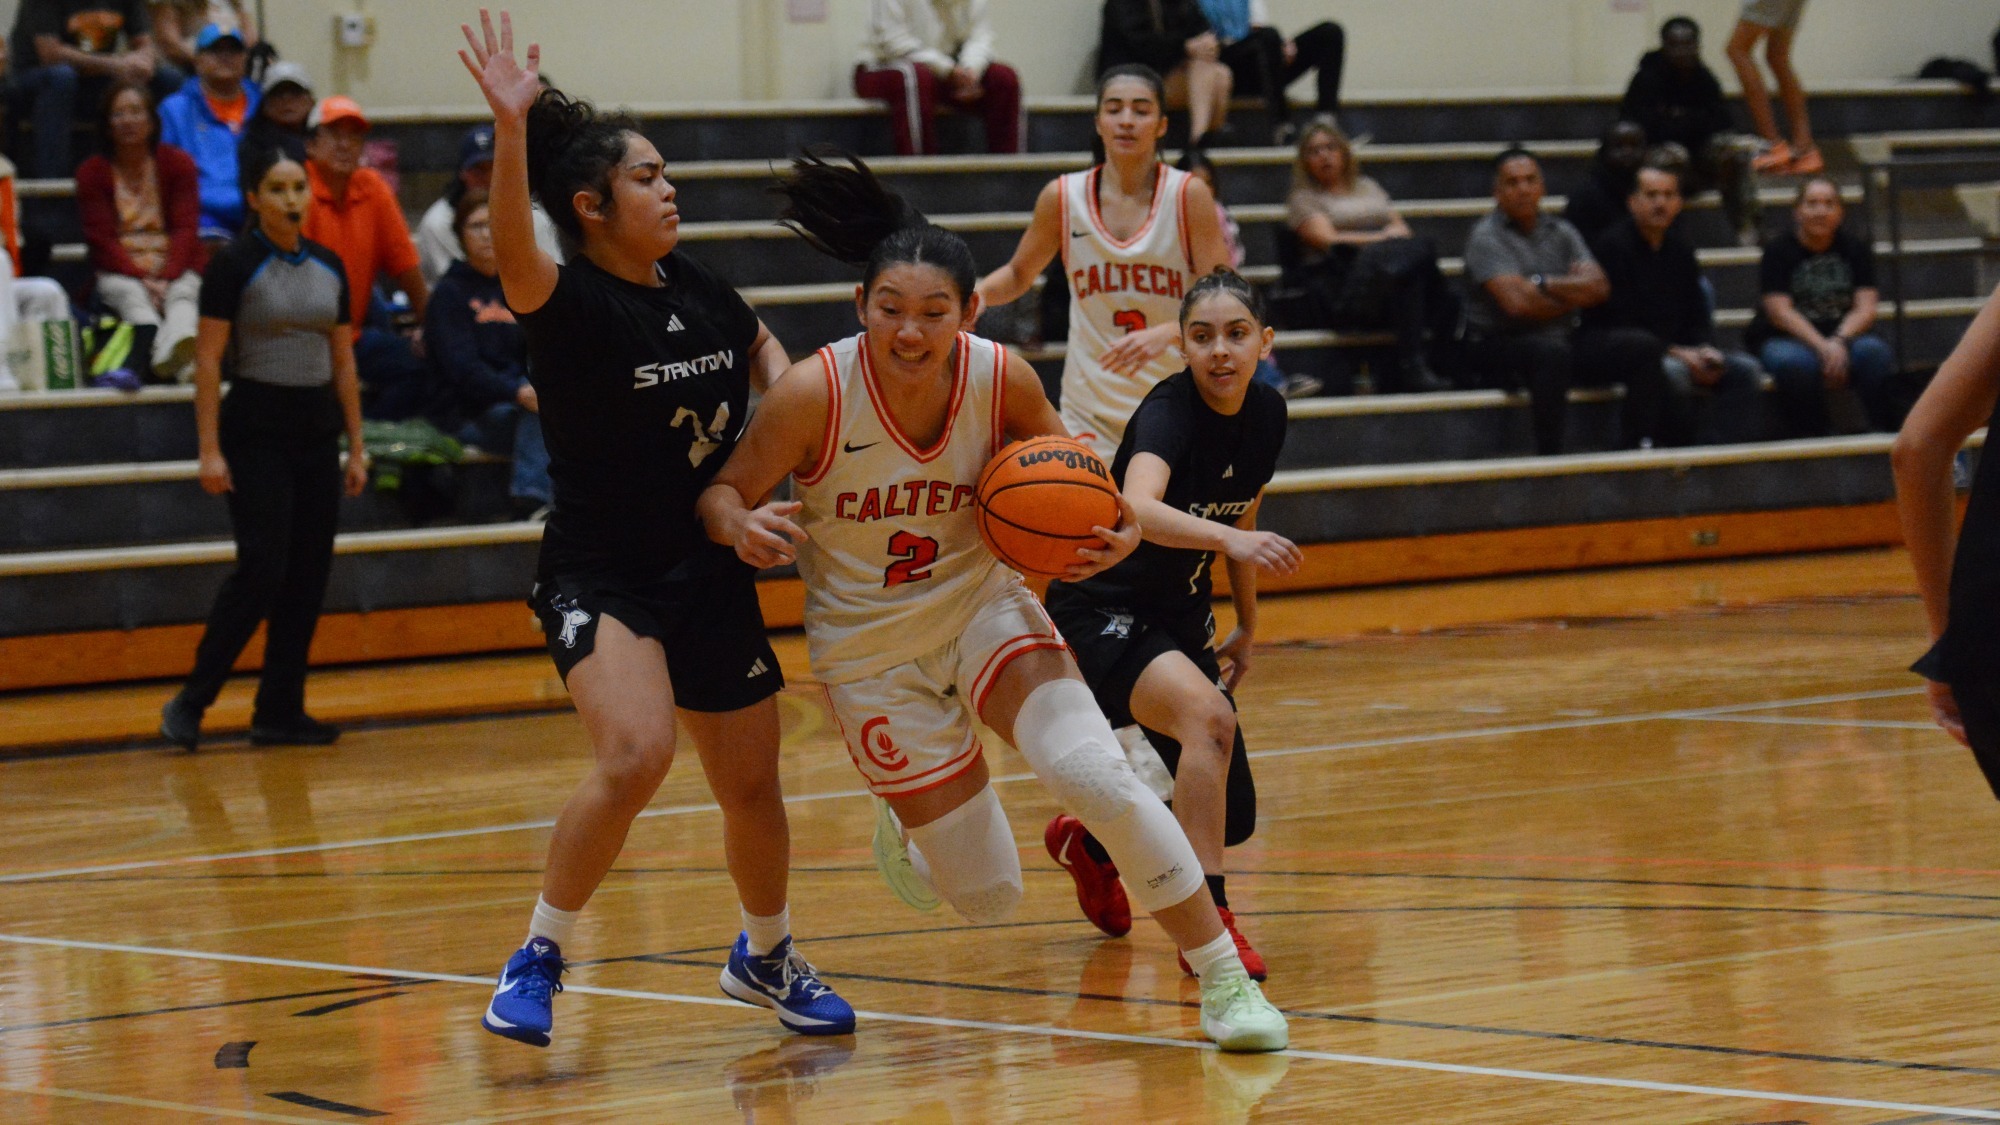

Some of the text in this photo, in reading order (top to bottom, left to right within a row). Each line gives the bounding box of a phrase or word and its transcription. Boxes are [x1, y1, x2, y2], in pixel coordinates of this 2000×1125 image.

[1073, 262, 1184, 300] CALTECH
[633, 349, 734, 390] STANTON
[1018, 450, 1109, 482] Wilson
[883, 530, 939, 588] 2
